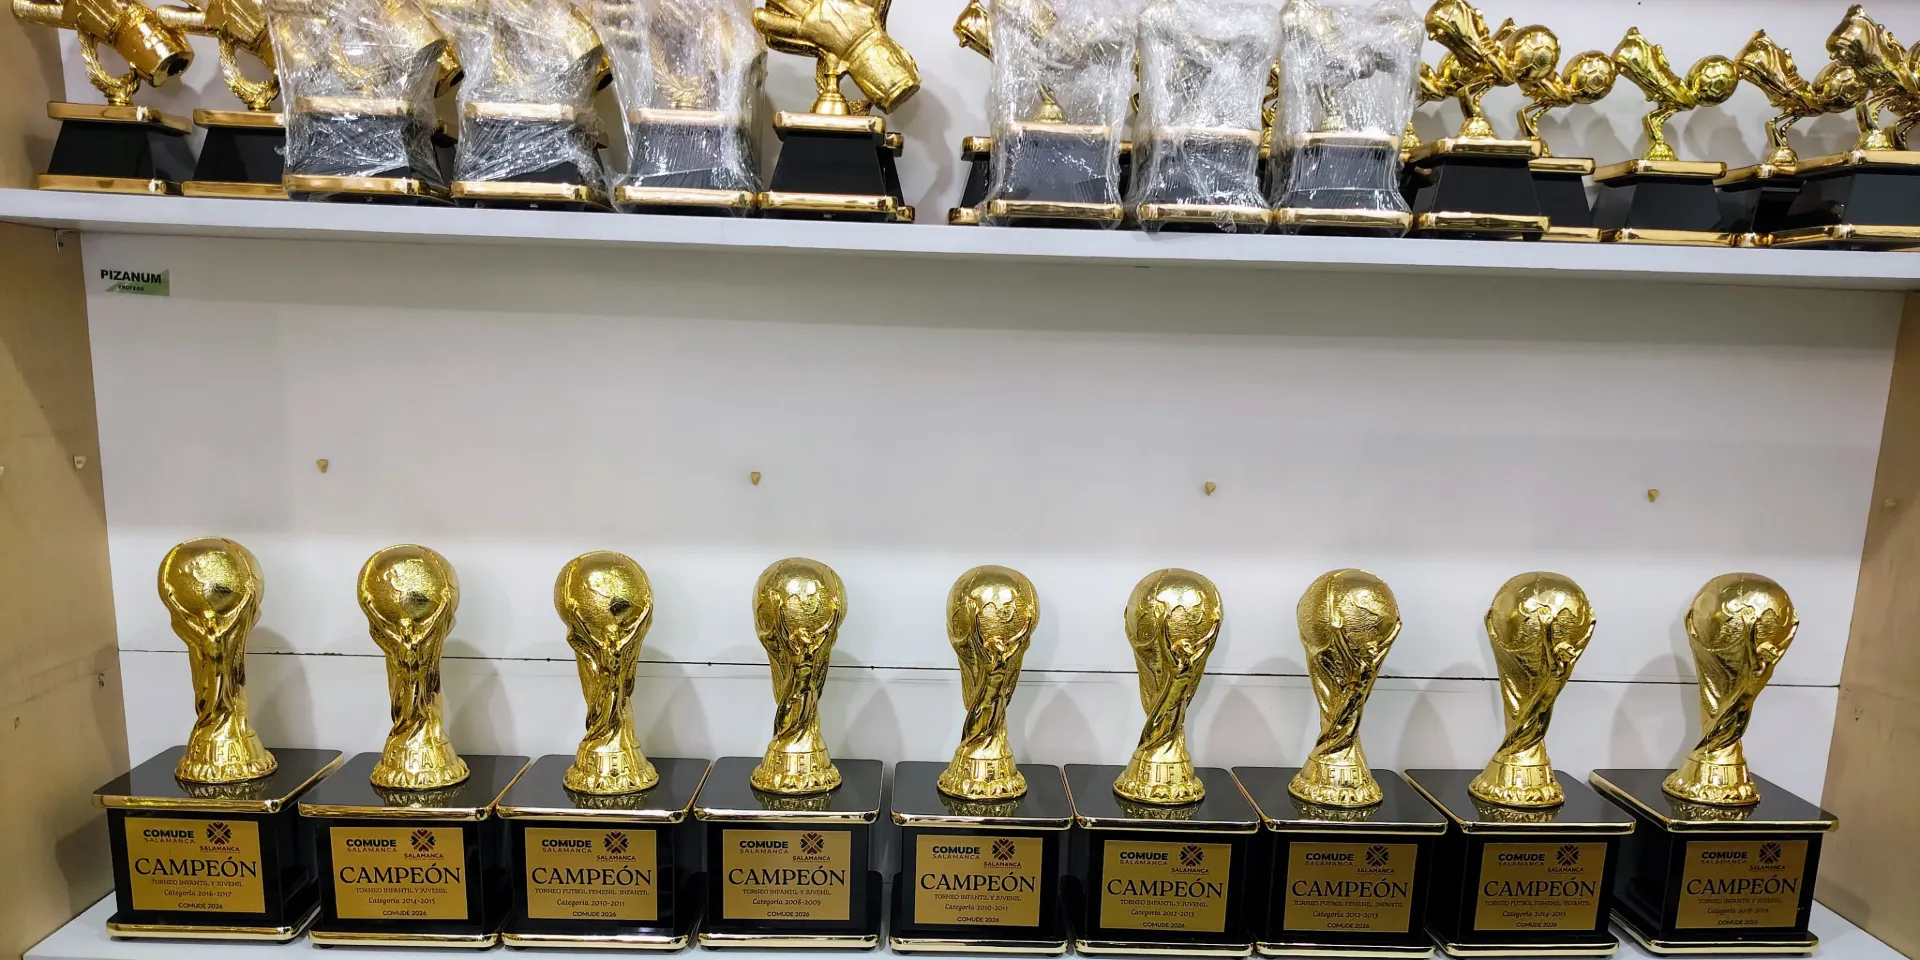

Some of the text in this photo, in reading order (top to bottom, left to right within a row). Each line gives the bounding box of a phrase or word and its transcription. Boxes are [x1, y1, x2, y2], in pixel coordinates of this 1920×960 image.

[100, 269, 162, 284] PIZANUM
[144, 829, 194, 838] COMUDE
[346, 839, 396, 847] COMUDE
[542, 839, 592, 847] COMUDE
[933, 846, 980, 854] COMUDE
[1120, 852, 1168, 860] COMUDE
[1306, 853, 1354, 861] COMUDE
[135, 856, 256, 877] CAMPEÓN
[340, 863, 460, 884] CAMPEÓN
[532, 865, 651, 886] CAMPEÓN
[729, 866, 845, 886] CAMPEÓN
[921, 872, 1035, 892] CAMPEÓN
[1107, 878, 1223, 898] CAMPEÓN
[1292, 878, 1408, 898] CAMPEÓN
[1484, 878, 1596, 897] CAMPEÓN
[1687, 875, 1798, 895] CAMPEÓN
